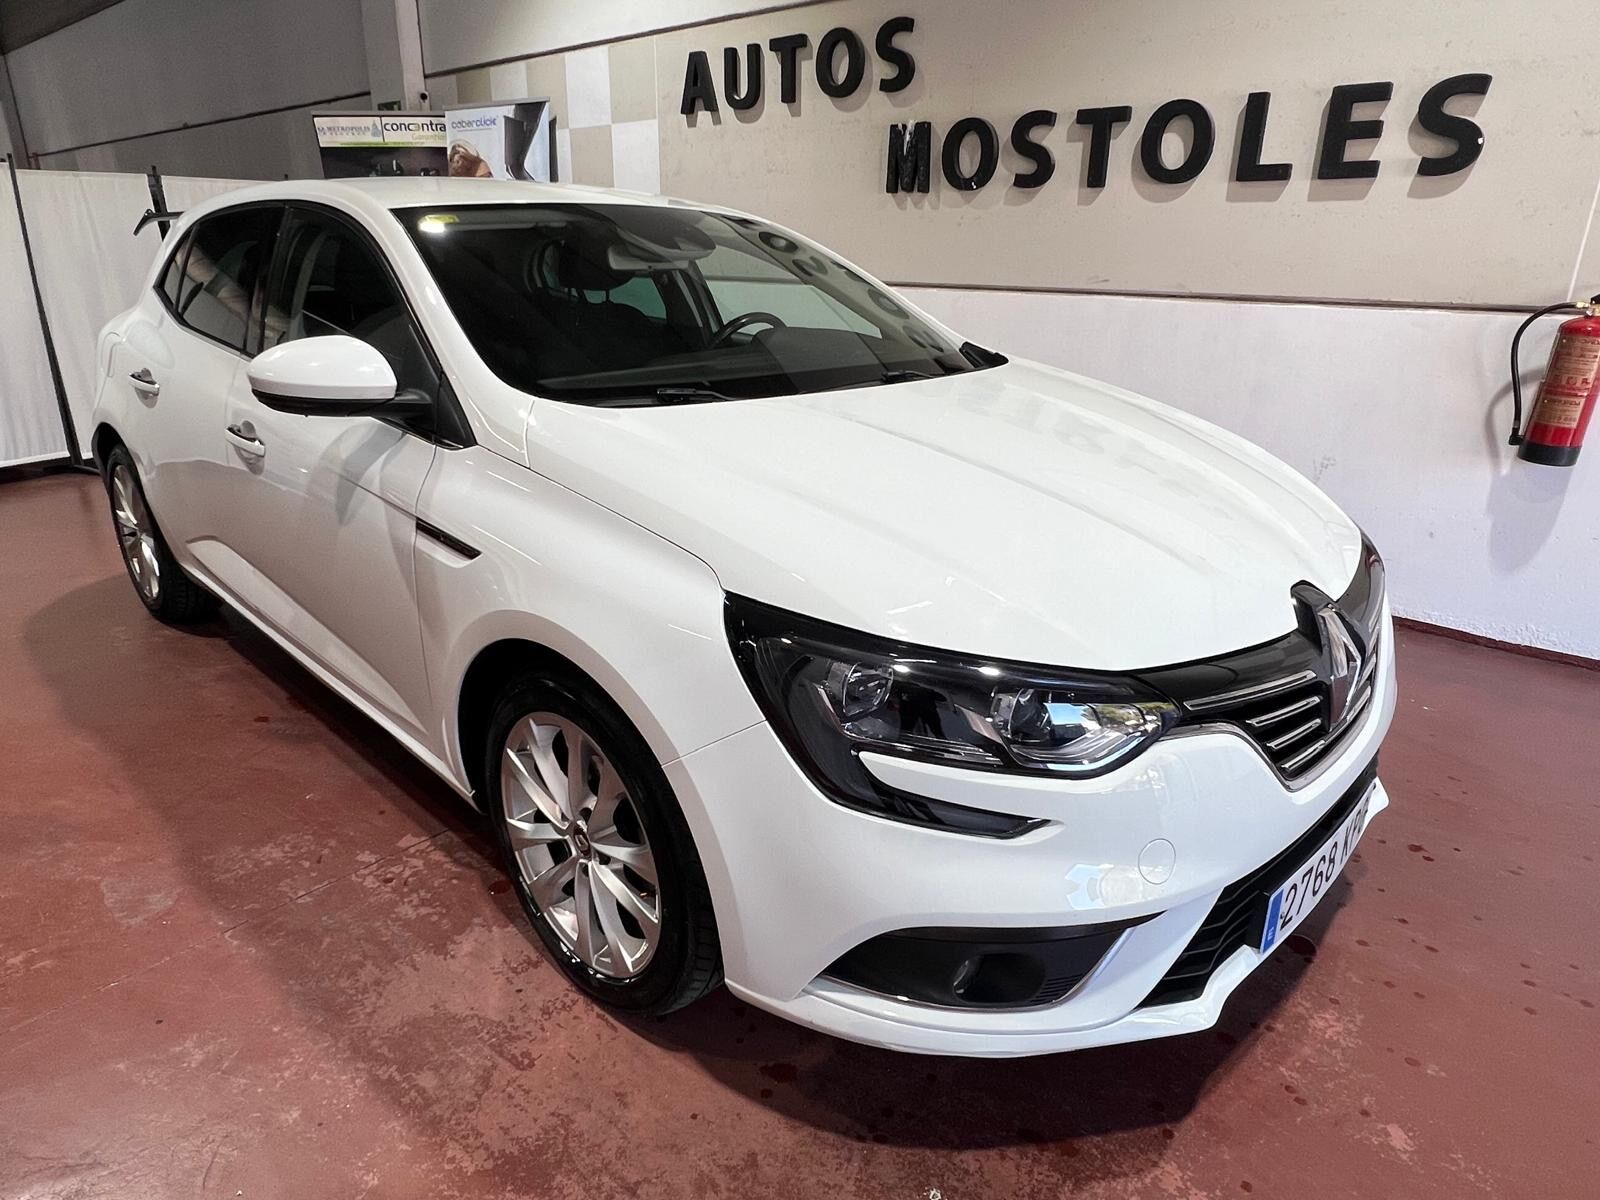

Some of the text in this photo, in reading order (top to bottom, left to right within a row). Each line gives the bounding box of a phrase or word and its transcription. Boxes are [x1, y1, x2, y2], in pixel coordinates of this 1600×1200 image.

[680, 16, 916, 116] AUTOS
[885, 73, 1493, 194] MOSTOLES
[1279, 840, 1338, 931] 2768
